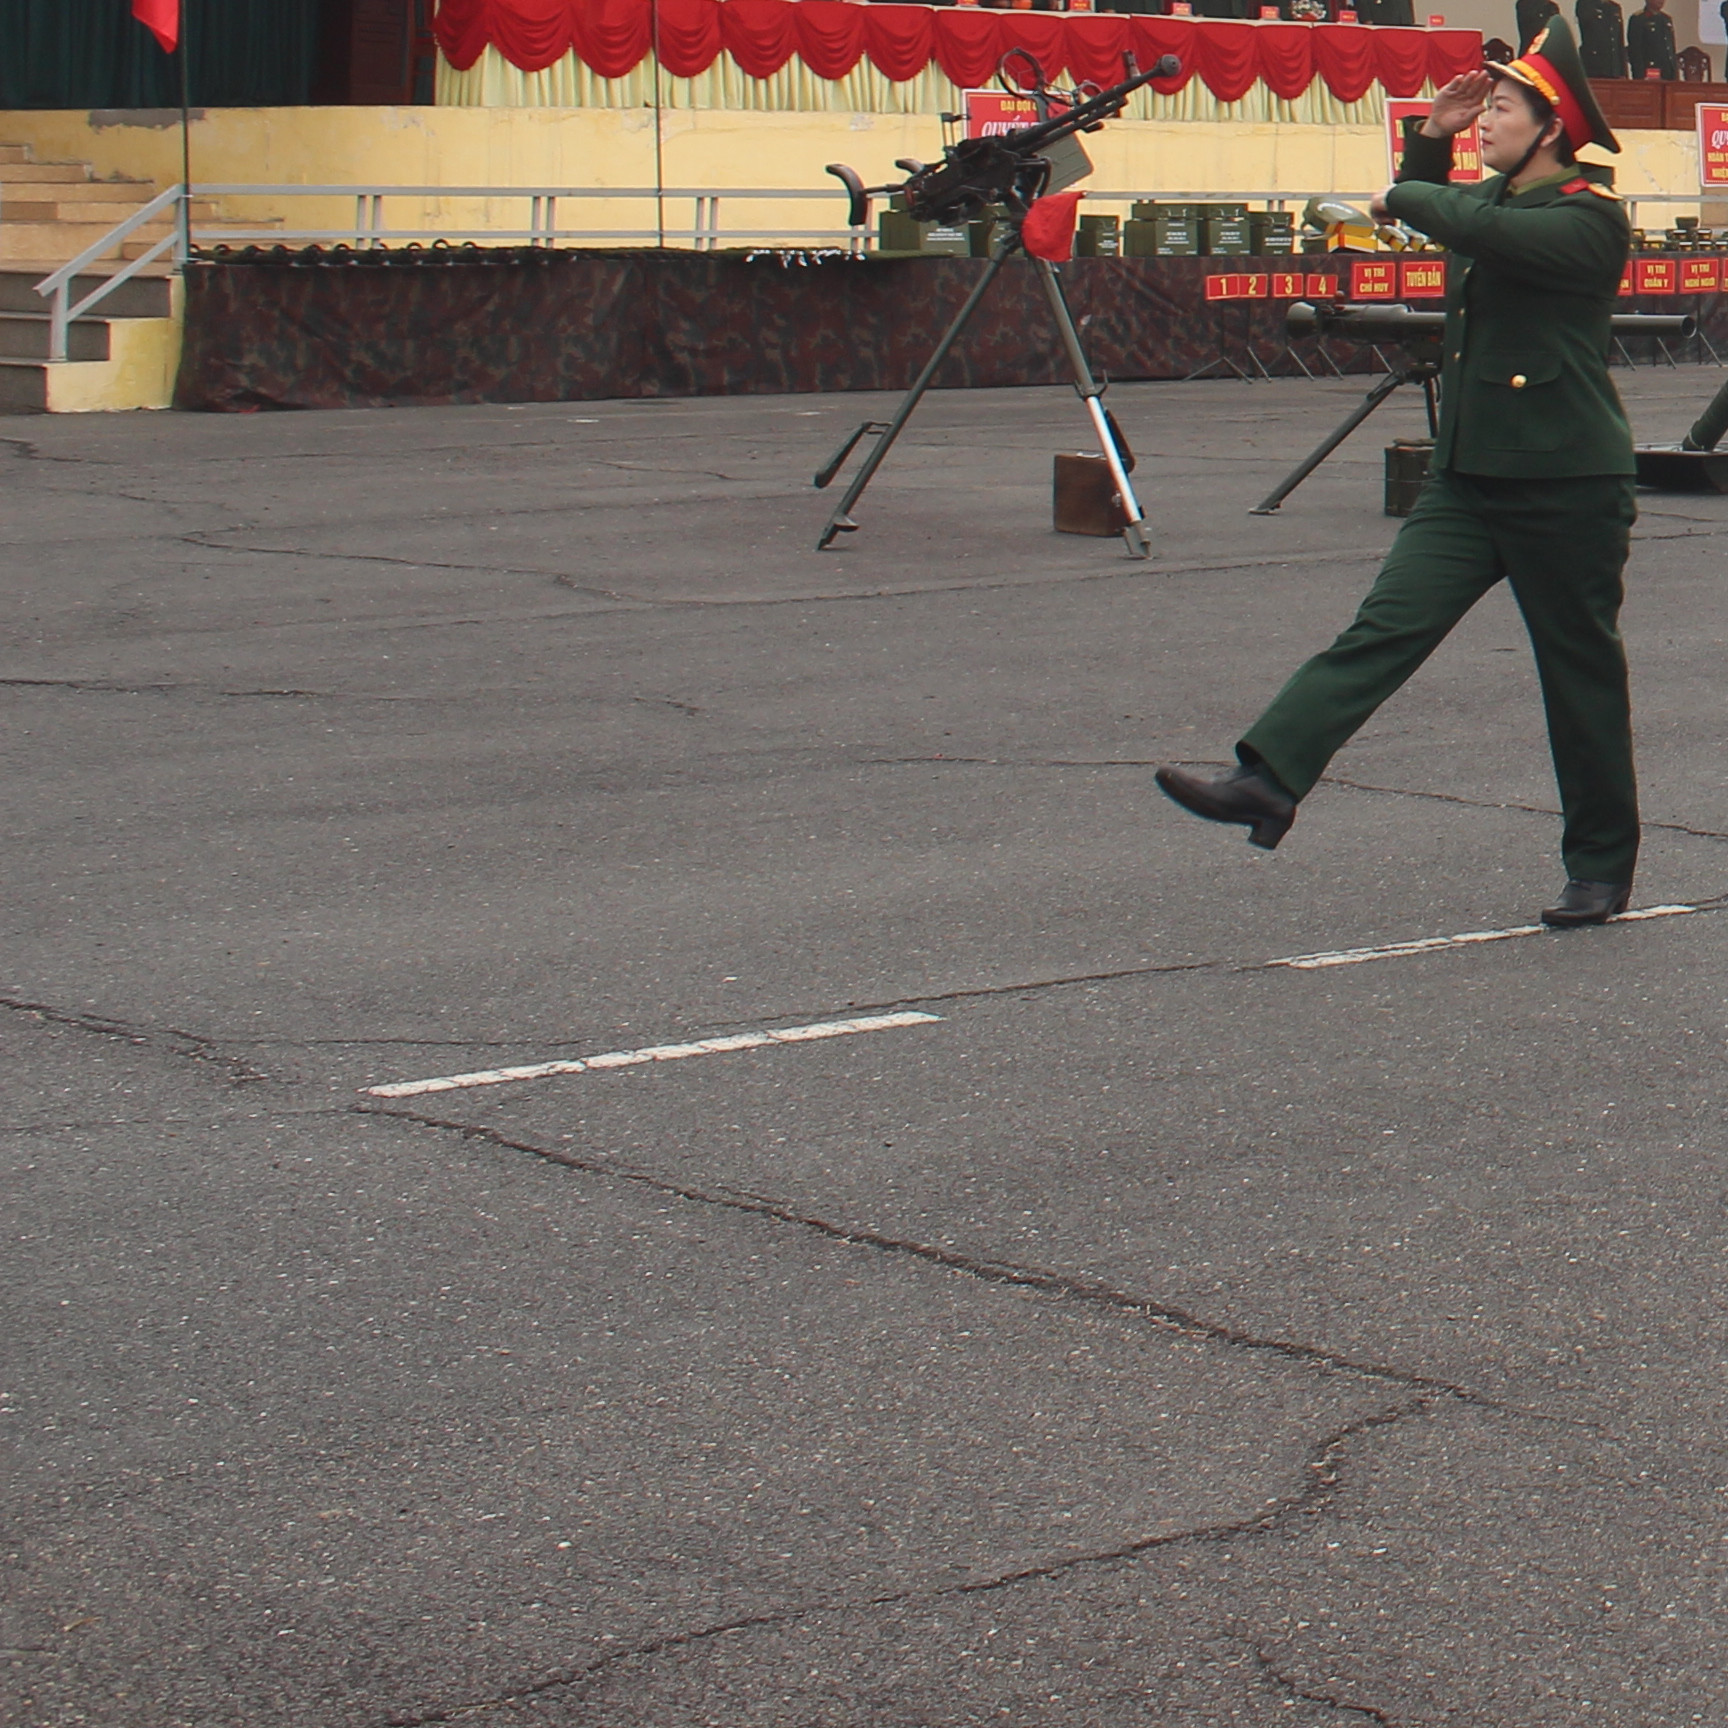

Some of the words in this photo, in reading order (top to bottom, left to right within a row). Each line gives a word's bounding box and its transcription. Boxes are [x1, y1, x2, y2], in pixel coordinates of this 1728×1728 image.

[1219, 278, 1228, 296] 1
[1248, 277, 1257, 295] 2
[1284, 276, 1293, 294] 3
[1318, 275, 1327, 293] 4
